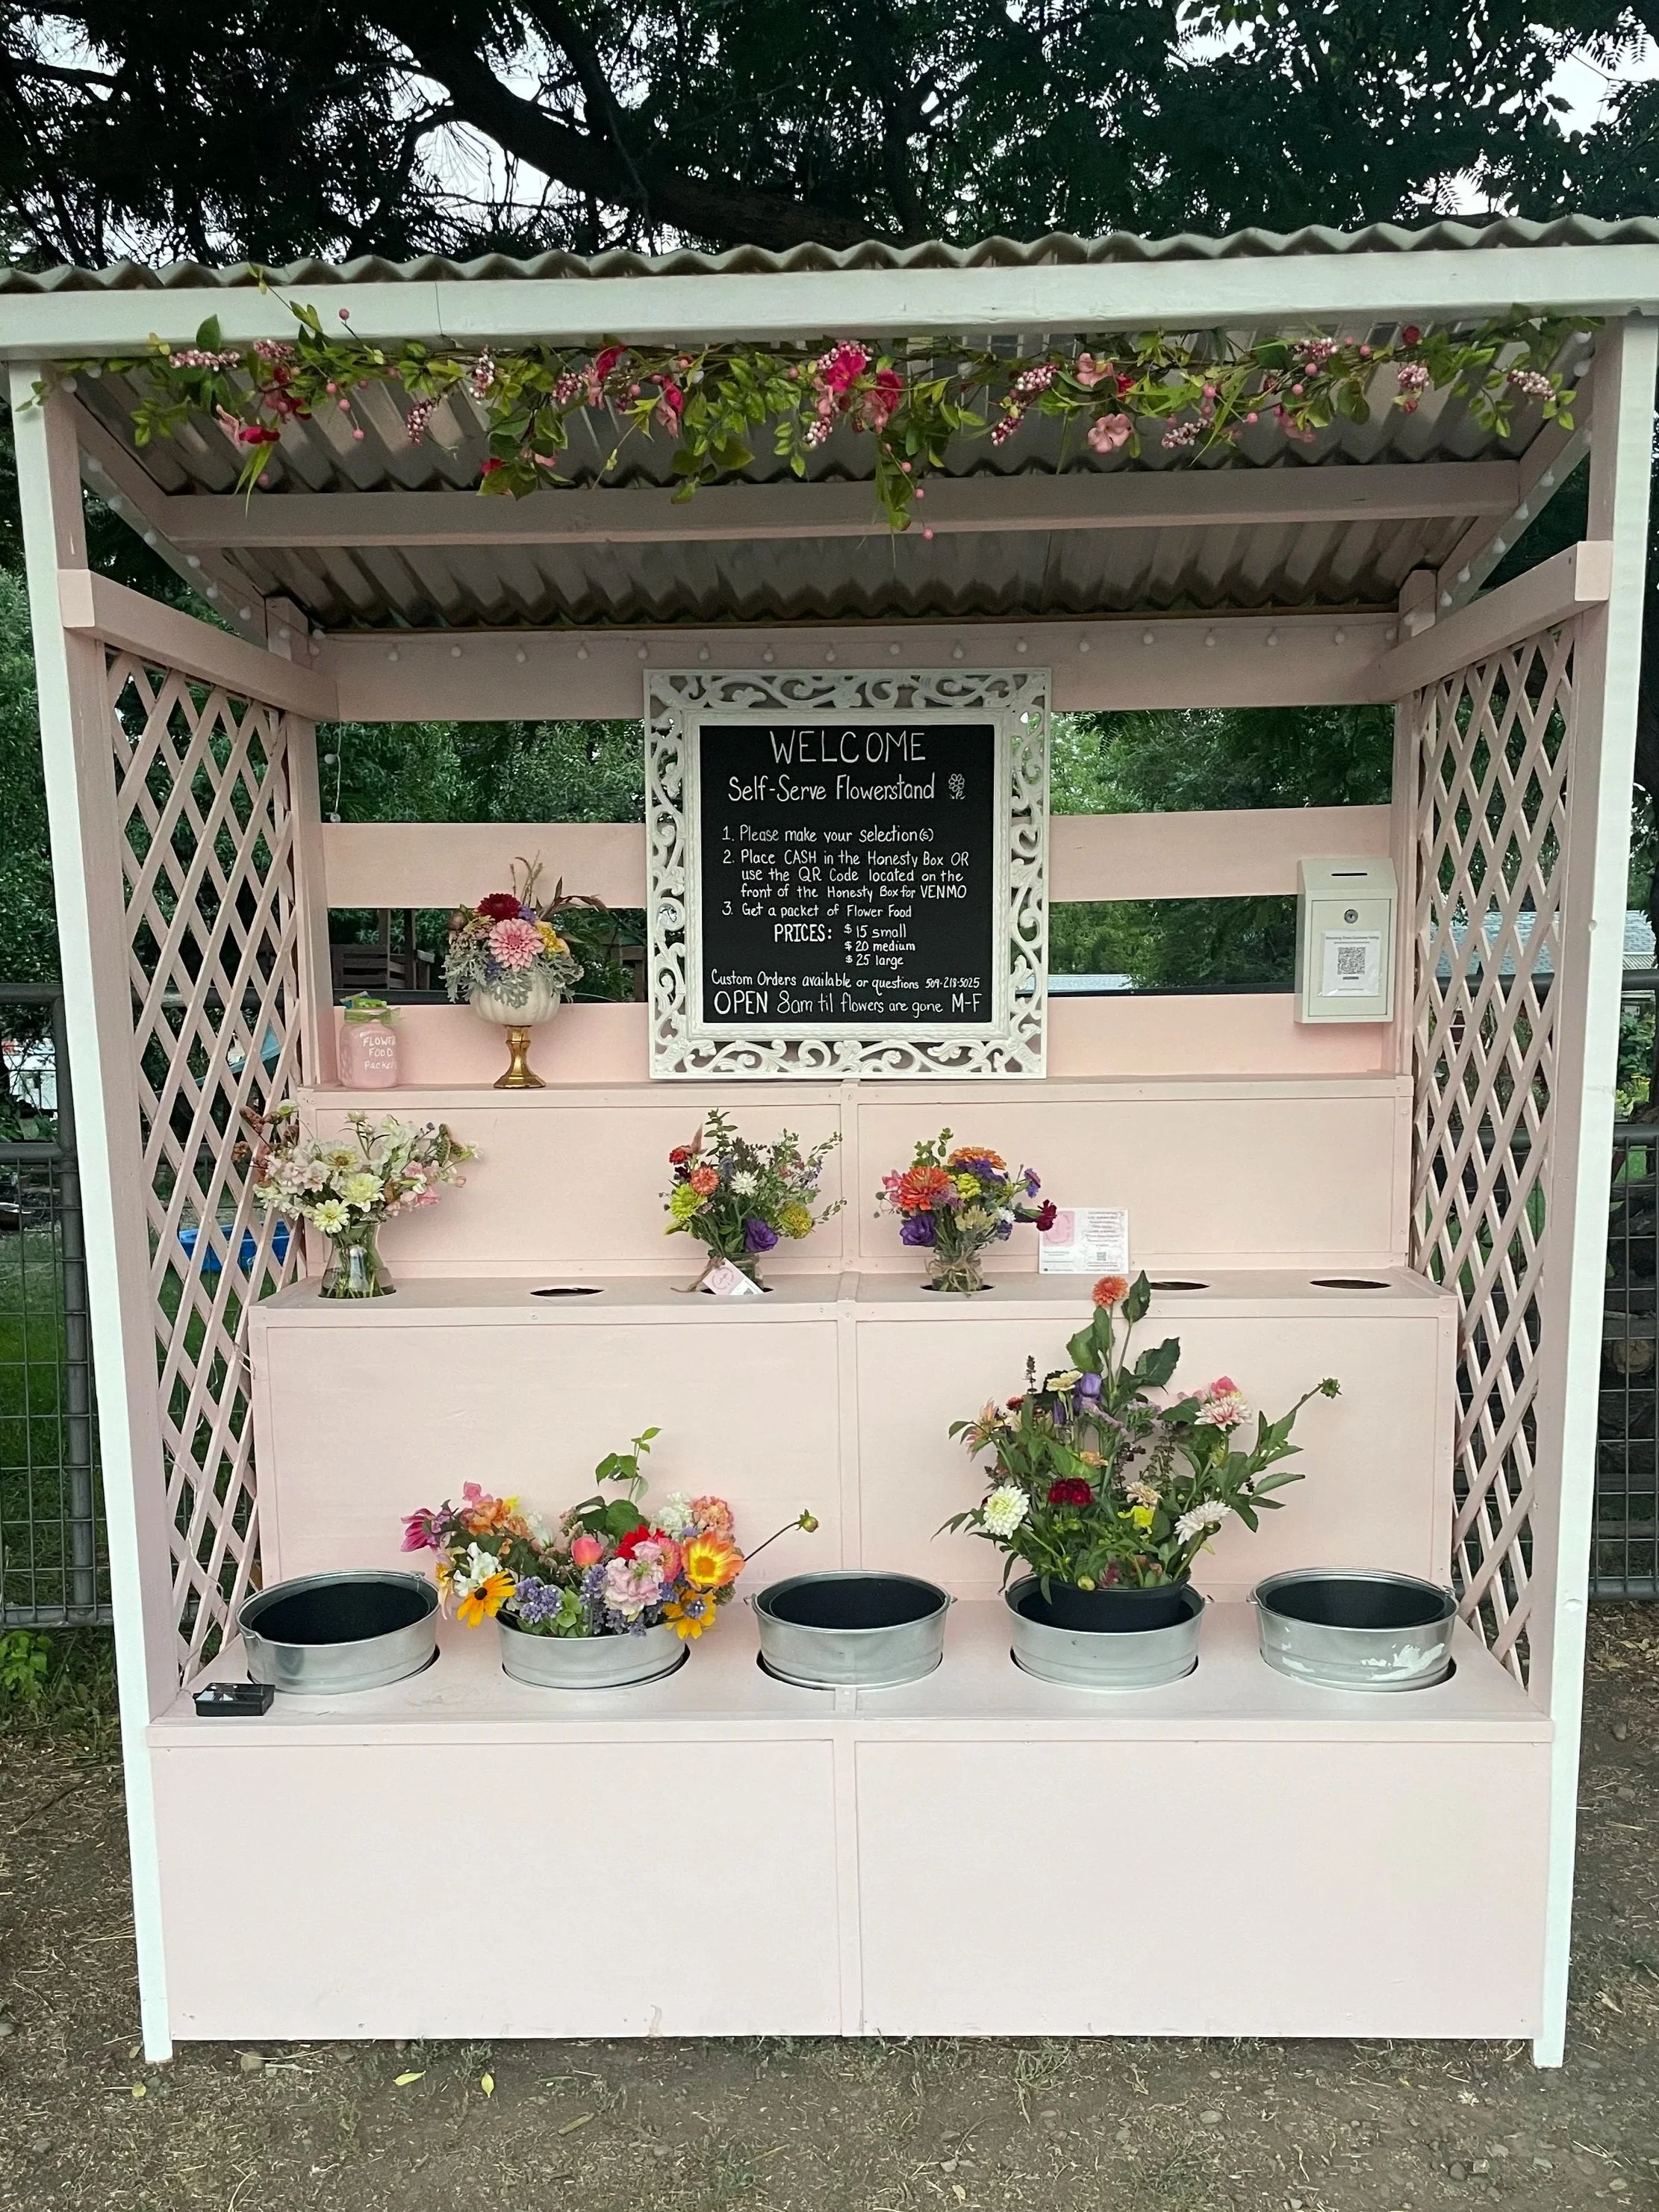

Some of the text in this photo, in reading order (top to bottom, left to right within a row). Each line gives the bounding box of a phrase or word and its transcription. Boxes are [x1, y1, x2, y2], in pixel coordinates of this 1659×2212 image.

[770, 729, 927, 764] WELCOME
[727, 771, 936, 802] Self-Serve Flowerstand
[721, 824, 735, 842] 1.
[739, 824, 779, 842] Please
[785, 827, 818, 842] make
[823, 830, 853, 843] your
[722, 848, 970, 868] 2. Place CASH in the Honesty Box OR
[741, 866, 964, 883] use the QR Code located on the
[741, 883, 967, 903] front of the Honesty Box for VENMO
[722, 901, 912, 919] 3. Get a packet of Flower Food
[774, 923, 832, 942] PRICES:
[871, 923, 906, 939] small
[873, 939, 916, 952] medium
[875, 954, 904, 970] large
[711, 968, 753, 986] Custom
[756, 971, 797, 987] Orders
[802, 971, 852, 988] available
[856, 979, 868, 989] or
[871, 975, 920, 996] questions
[714, 990, 983, 1019] OPEN 8am til flowers are gone M-F
[369, 1047, 393, 1057] FOOD
